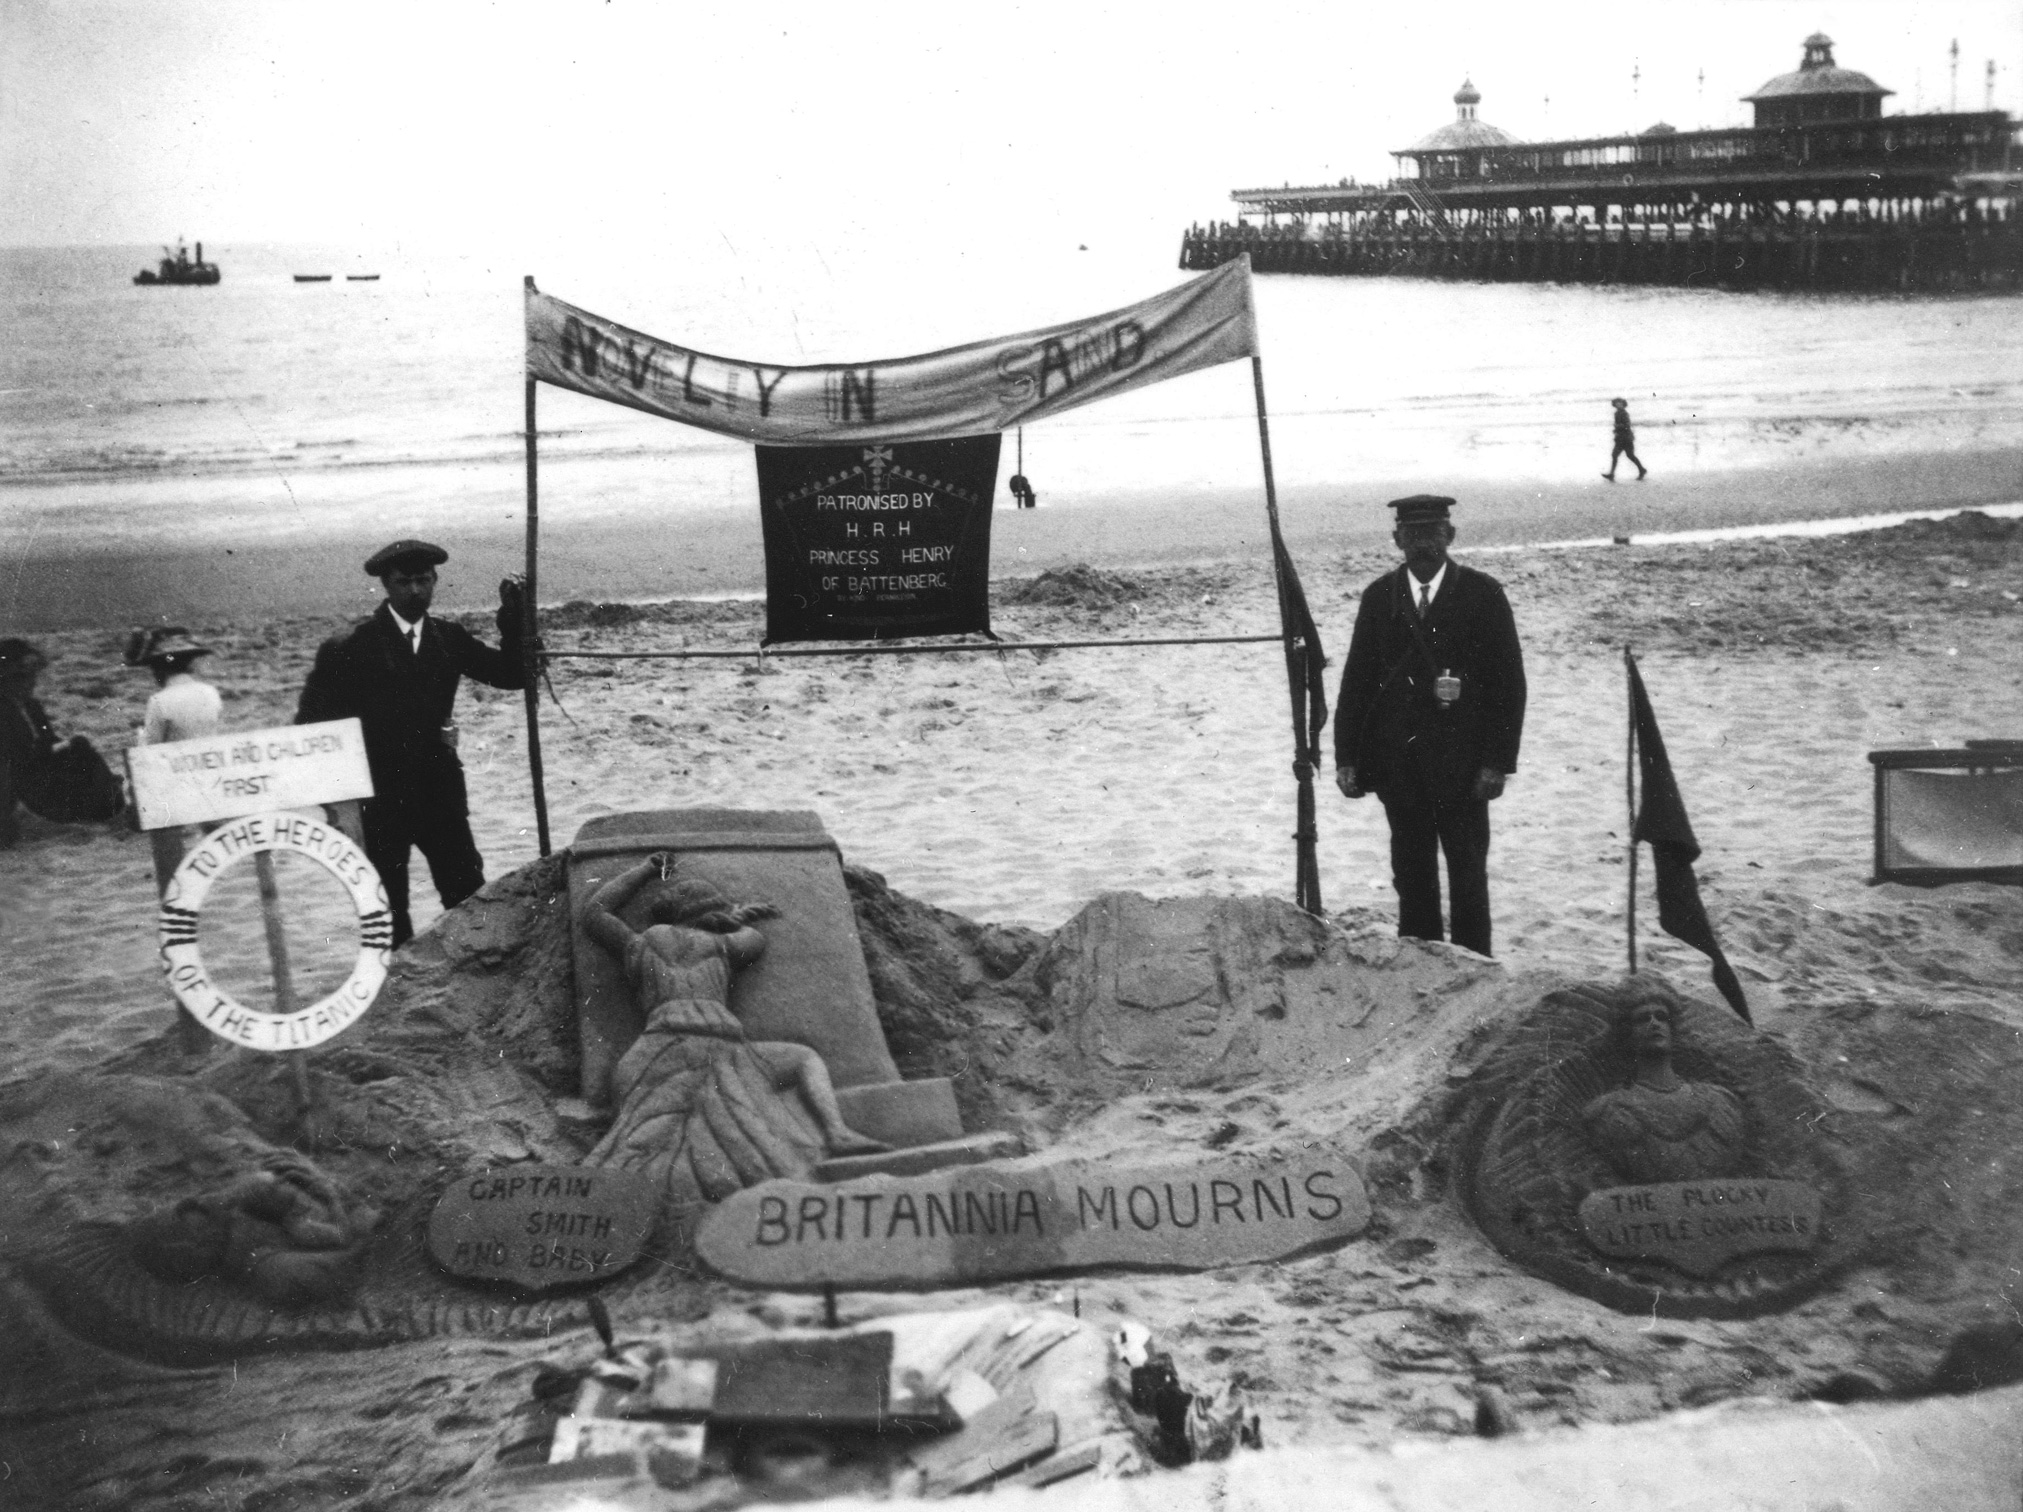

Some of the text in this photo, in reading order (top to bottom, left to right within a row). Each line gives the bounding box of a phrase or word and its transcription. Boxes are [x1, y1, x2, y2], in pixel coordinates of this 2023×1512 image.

[826, 369, 875, 424] IN
[996, 319, 1148, 400] SAND
[817, 492, 934, 511] PATRONISED BY
[809, 545, 954, 565] PRINCESS HENRY
[822, 573, 946, 591] OF BATTENBERG
[187, 819, 367, 885] TO THE HEROES
[174, 964, 368, 1045] OF THE TITANIC
[468, 1176, 593, 1200] CAPTAIN
[1610, 1186, 1768, 1213] THE PLUCKY
[756, 1170, 1344, 1247] BRITANNIA MOURNS
[525, 1211, 611, 1238] SMITH
[1607, 1218, 1694, 1245] LITTLE
[455, 1241, 508, 1267] AND
